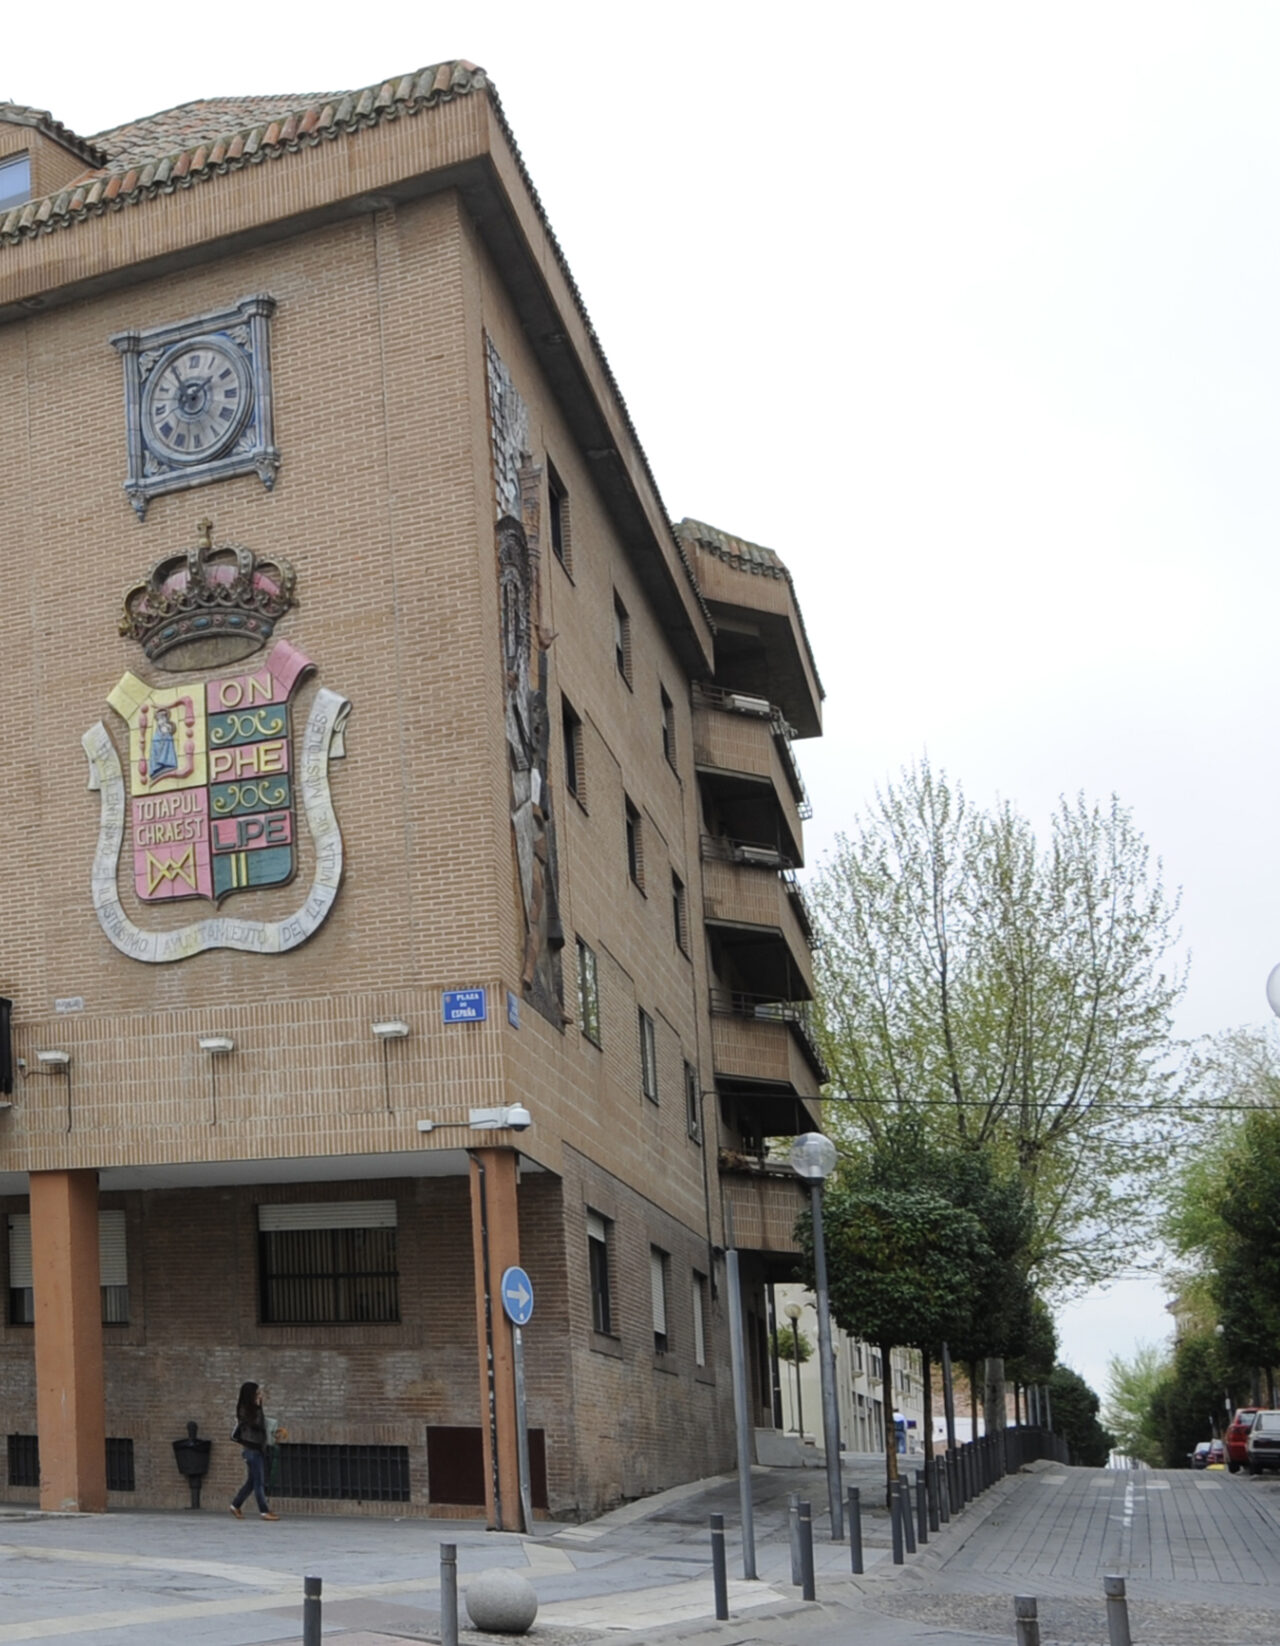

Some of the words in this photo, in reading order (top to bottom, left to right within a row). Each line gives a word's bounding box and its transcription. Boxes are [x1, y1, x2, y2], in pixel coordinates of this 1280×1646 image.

[219, 672, 274, 707] ON
[210, 744, 285, 780] PHE
[136, 794, 202, 821] TOTAPUL
[136, 818, 205, 846] CHRAEST
[213, 814, 288, 849] LIPE
[317, 811, 328, 833] DE
[320, 842, 336, 884] VILLA
[305, 898, 326, 920] LA
[163, 923, 267, 955] AYUNTAMIENTO
[282, 921, 302, 944] DE
[456, 993, 480, 1001] PLAZA
[451, 1007, 477, 1018] ESPAÑA
